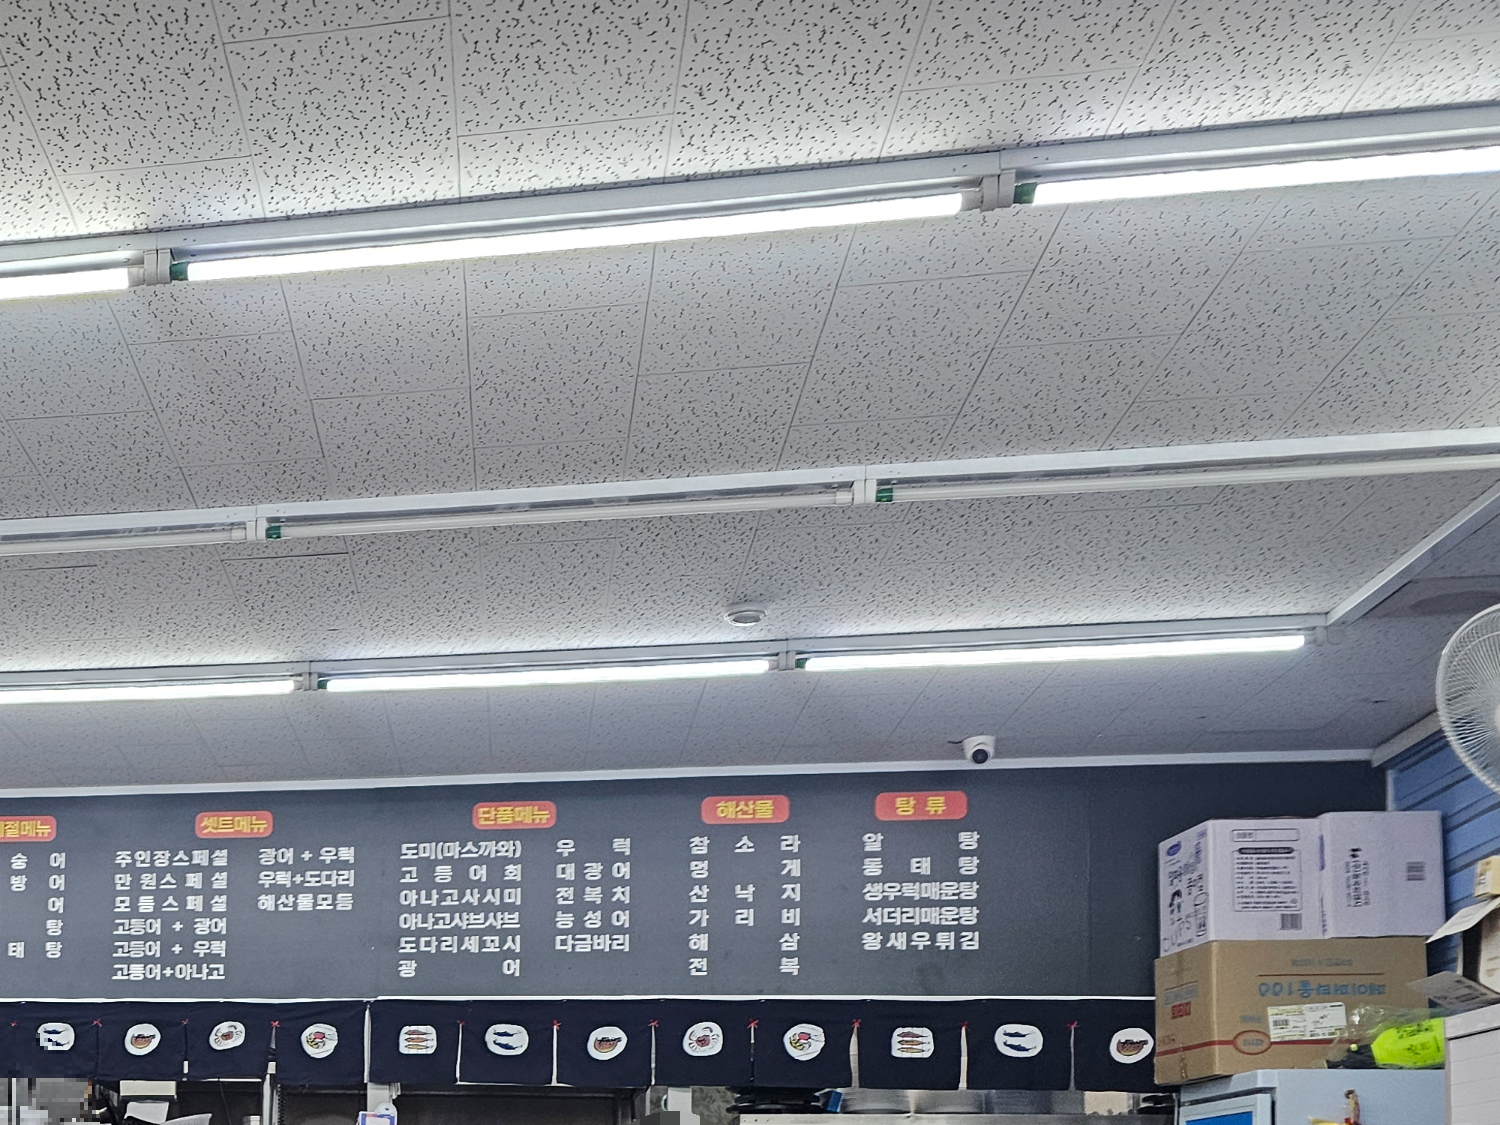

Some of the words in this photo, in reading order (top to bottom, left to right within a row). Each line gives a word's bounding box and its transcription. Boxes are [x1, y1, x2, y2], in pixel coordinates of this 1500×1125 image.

[477, 805, 550, 825] 단품메뉴
[716, 799, 774, 819] 해산물
[201, 815, 268, 833] 셋트메뉴
[115, 849, 227, 868] 주인장스페셜
[259, 848, 293, 865] 광어
[319, 847, 354, 864] 우럭
[400, 841, 521, 859] 도미(마스까와)
[258, 870, 354, 888] 우럭+도다리
[400, 888, 521, 907] 아나고사시미
[862, 882, 979, 900] 생우럭매운탕
[258, 893, 353, 911] 해산물모듬
[399, 912, 520, 930] 아나고샤브샤브
[862, 907, 979, 925] 서더리매운탕
[113, 918, 161, 935] 고등어
[194, 918, 226, 934] 광어
[113, 941, 160, 957] 고등어
[193, 940, 226, 957] 우럭
[399, 935, 520, 953] 도다리세꼬시
[555, 934, 629, 952] 다금바리
[112, 964, 225, 980] 고등어+아나고
